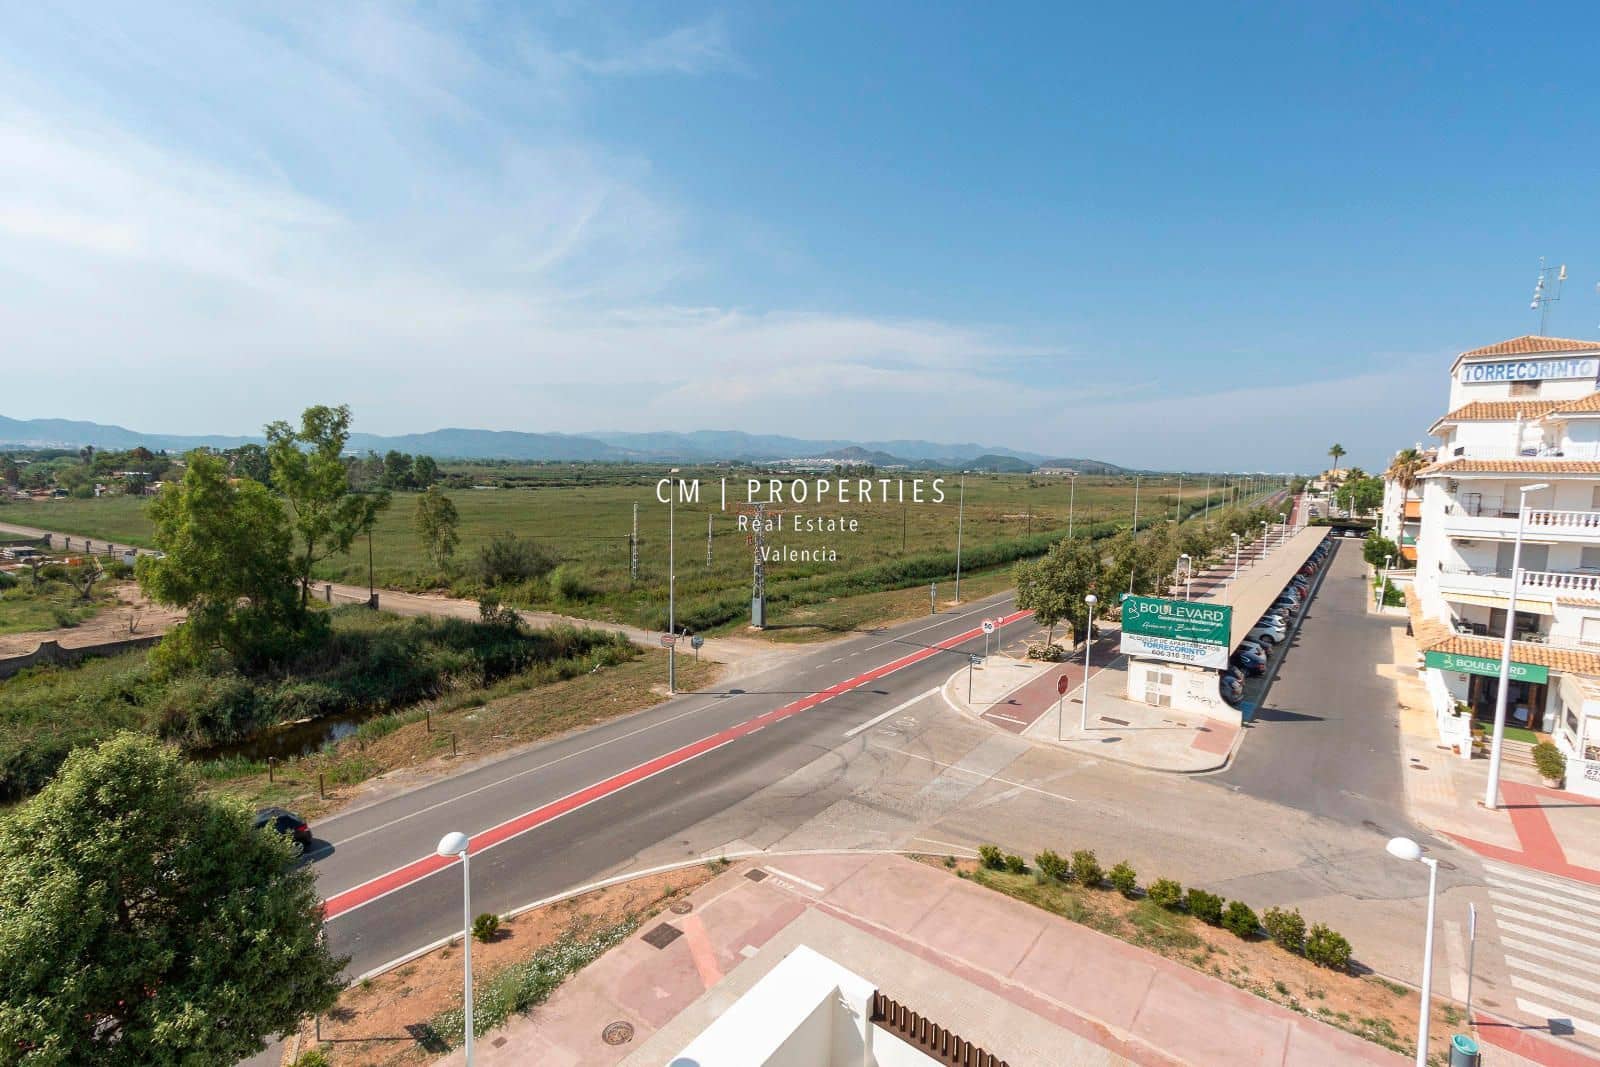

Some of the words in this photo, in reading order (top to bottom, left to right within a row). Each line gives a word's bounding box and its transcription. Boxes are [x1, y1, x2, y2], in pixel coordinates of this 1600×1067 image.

[1464, 360, 1592, 381] TORRECORINTO
[1140, 602, 1224, 621] BOULEVARD
[1143, 642, 1207, 656] TORRECORINTO
[1456, 659, 1527, 675] BOULEVRD
